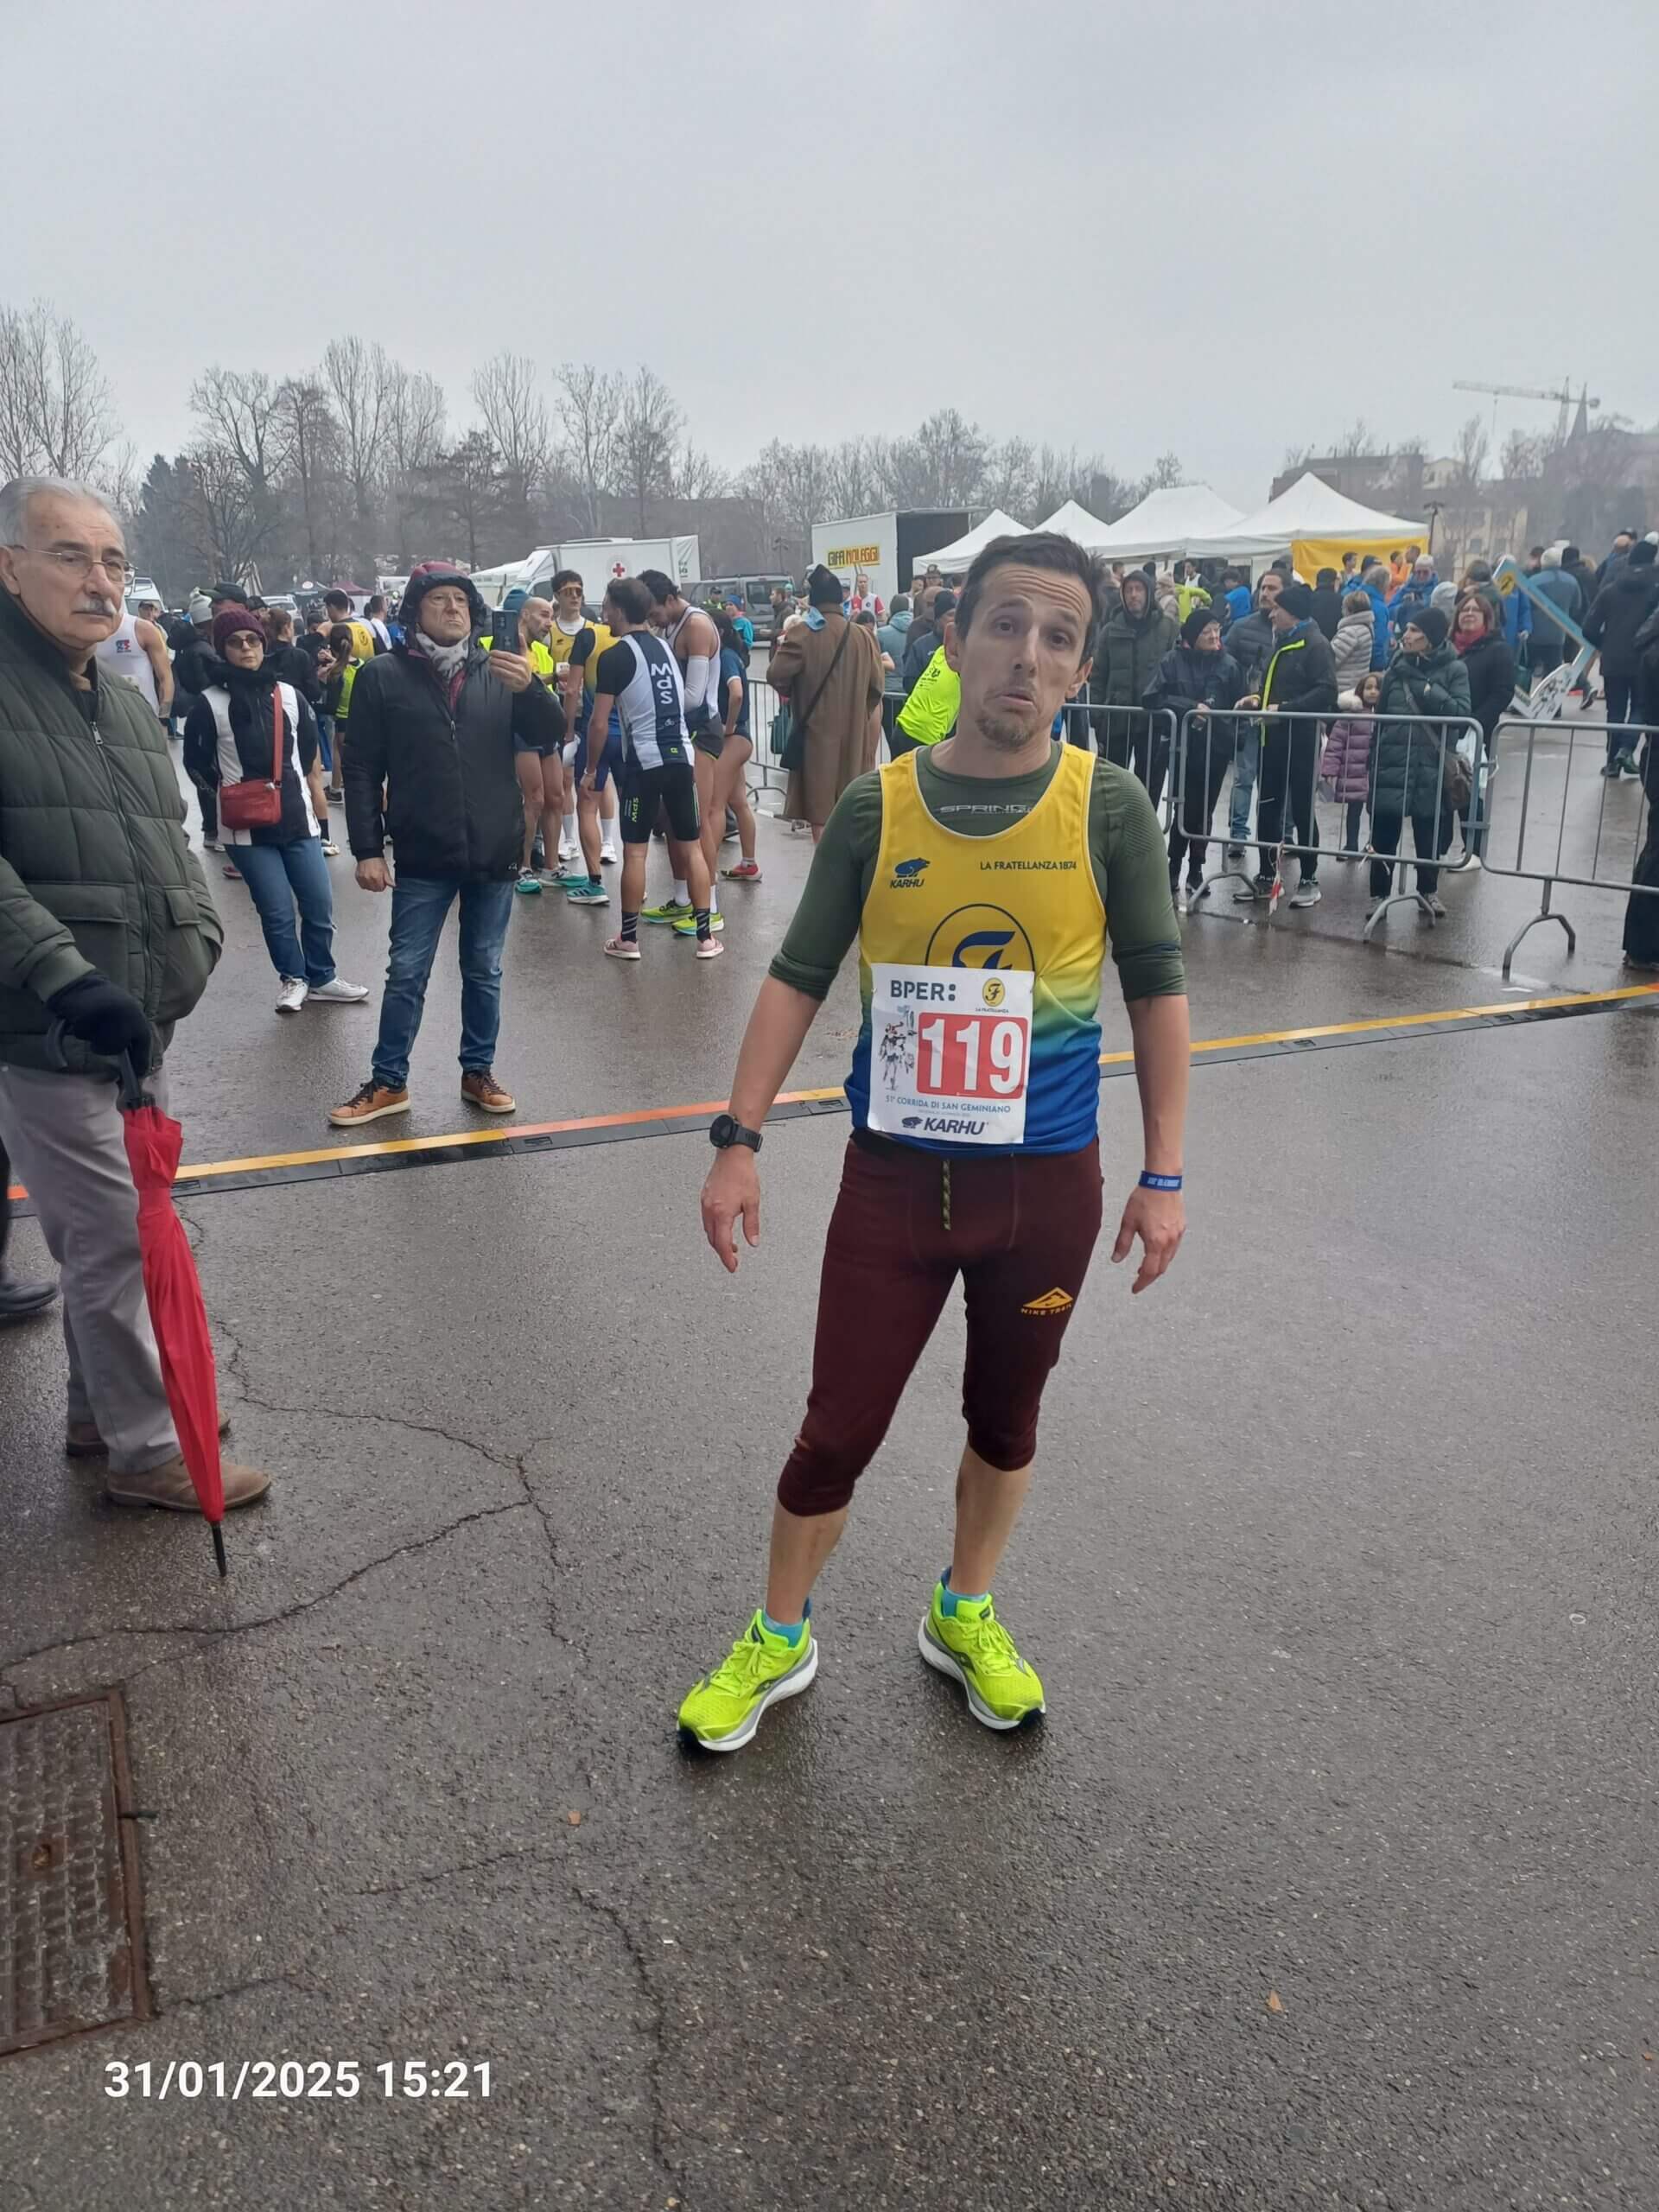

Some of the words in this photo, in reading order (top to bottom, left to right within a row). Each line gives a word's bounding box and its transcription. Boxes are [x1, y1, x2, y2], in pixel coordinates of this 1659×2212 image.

[980, 861, 992, 870] LA
[995, 861, 1058, 870] FRATELLANZA
[1059, 861, 1077, 870] 1874
[890, 878, 925, 888] KARHU
[922, 1019, 1023, 1094] 119
[897, 1096, 929, 1108] CORRIDA
[942, 1103, 959, 1111] SAN
[961, 1103, 1011, 1113] GEMINIANO
[924, 1116, 985, 1135] KARHU
